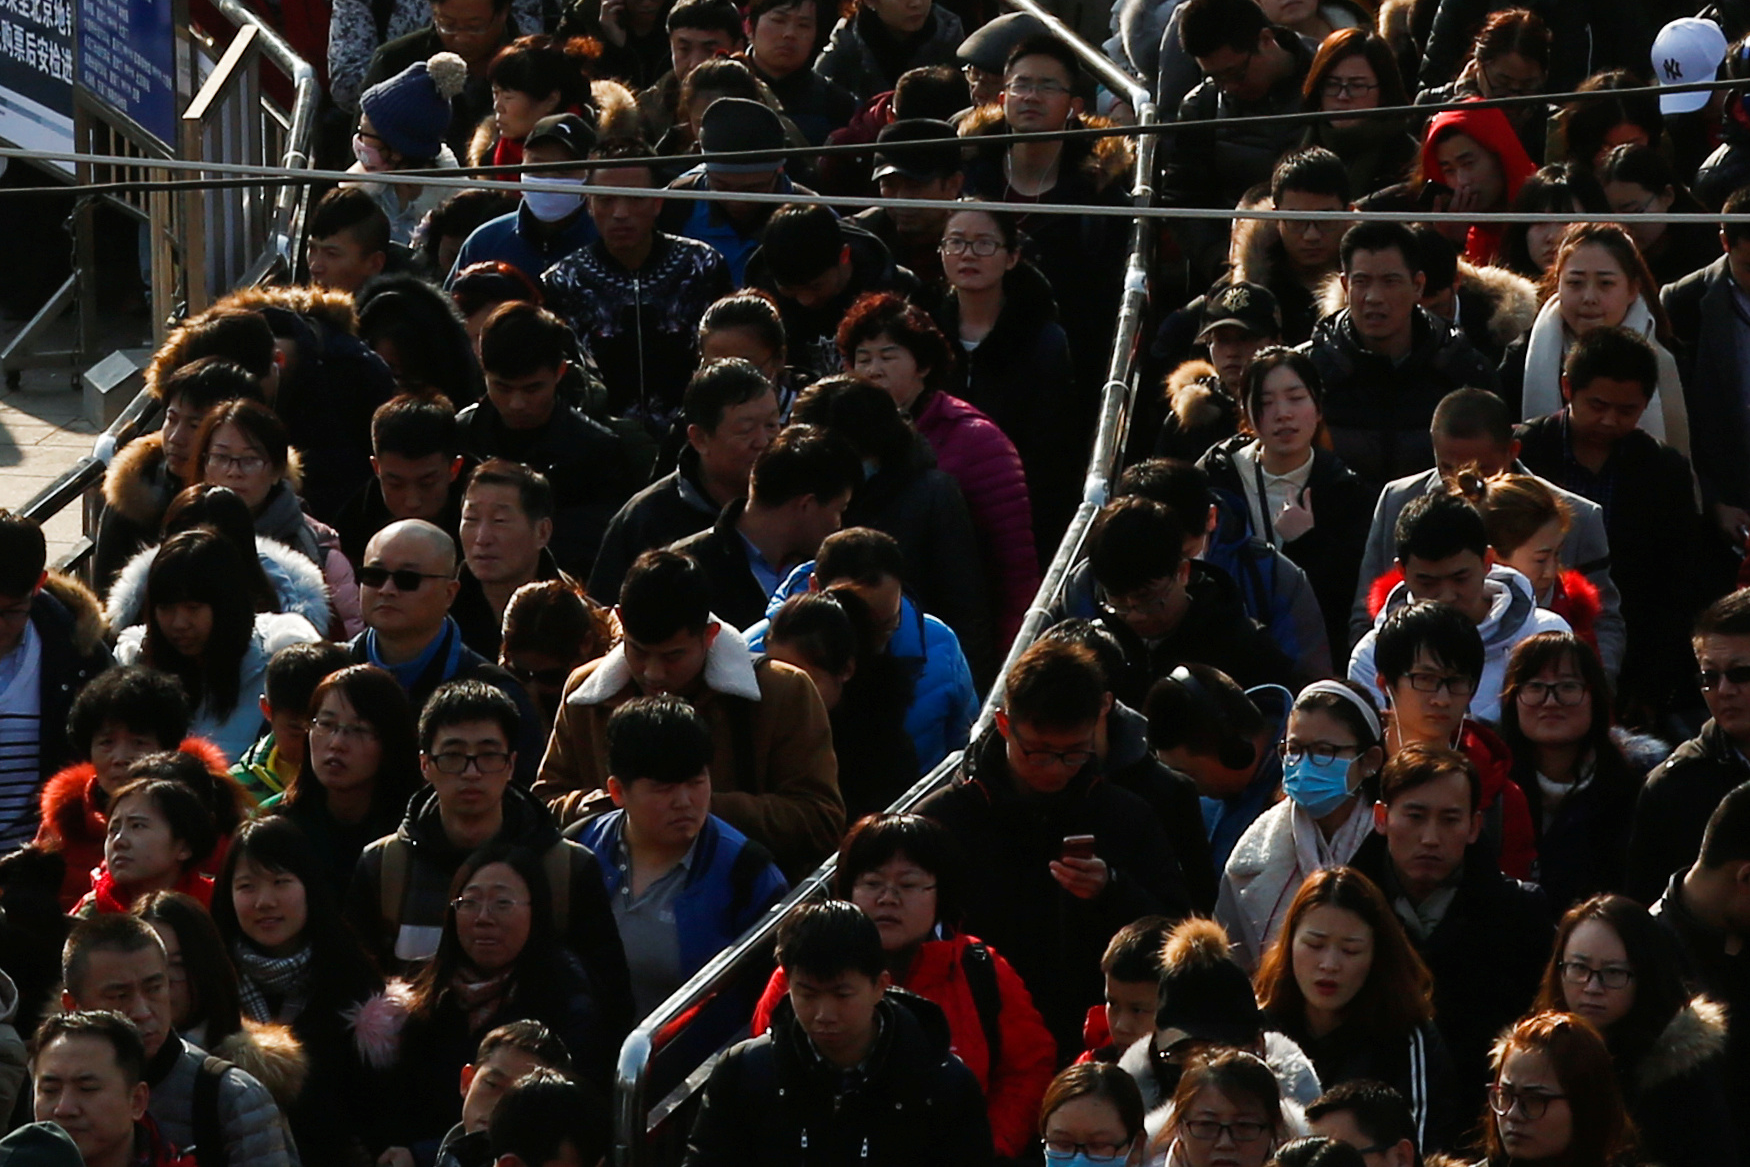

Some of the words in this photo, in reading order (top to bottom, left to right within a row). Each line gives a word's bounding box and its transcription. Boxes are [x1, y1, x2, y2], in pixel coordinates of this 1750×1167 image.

[0, 19, 74, 86] 购票后安检进
